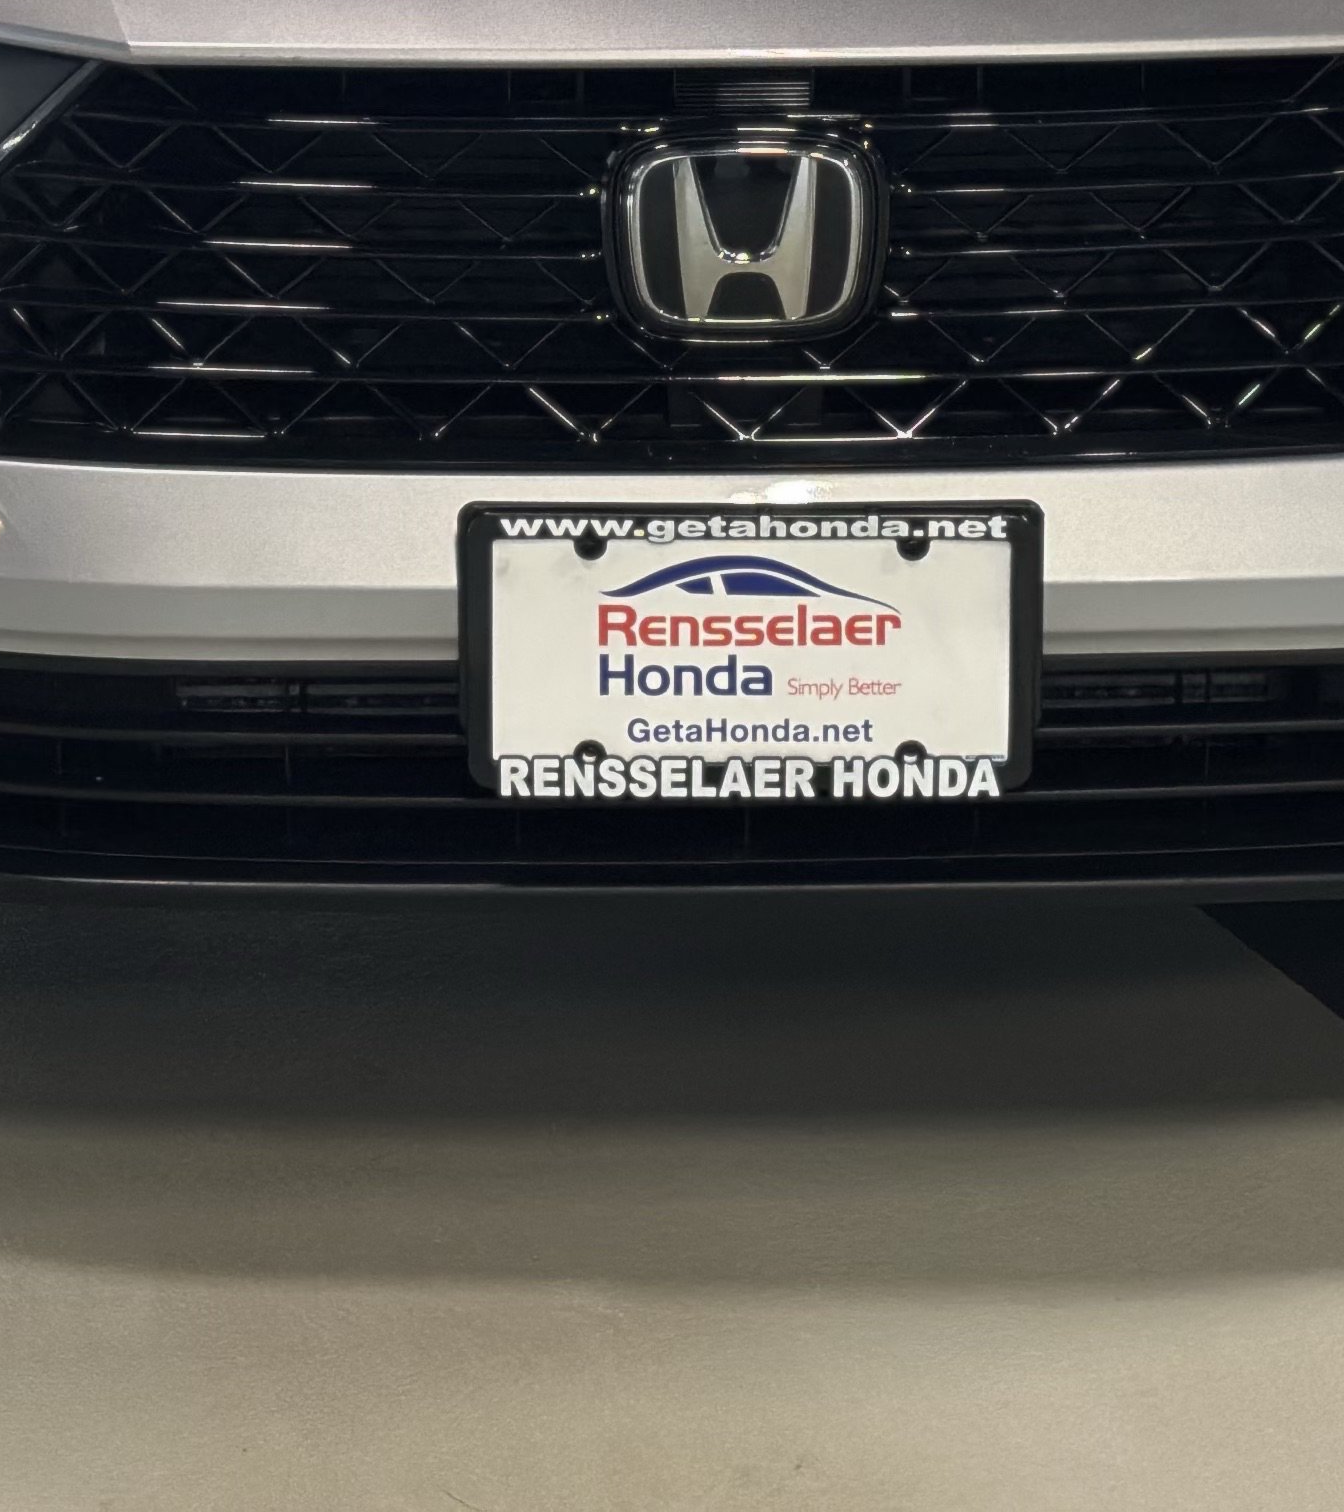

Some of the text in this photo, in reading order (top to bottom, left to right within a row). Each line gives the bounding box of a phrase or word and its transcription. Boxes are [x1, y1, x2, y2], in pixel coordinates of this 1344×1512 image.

[500, 515, 1008, 543] www.getahonda.net
[598, 604, 902, 646] Rensselaer
[598, 654, 773, 696] Honda
[787, 677, 902, 700] Simply Better
[627, 718, 874, 743] GetaHonda.net
[500, 758, 1000, 797] RENSSELAER HONDA
